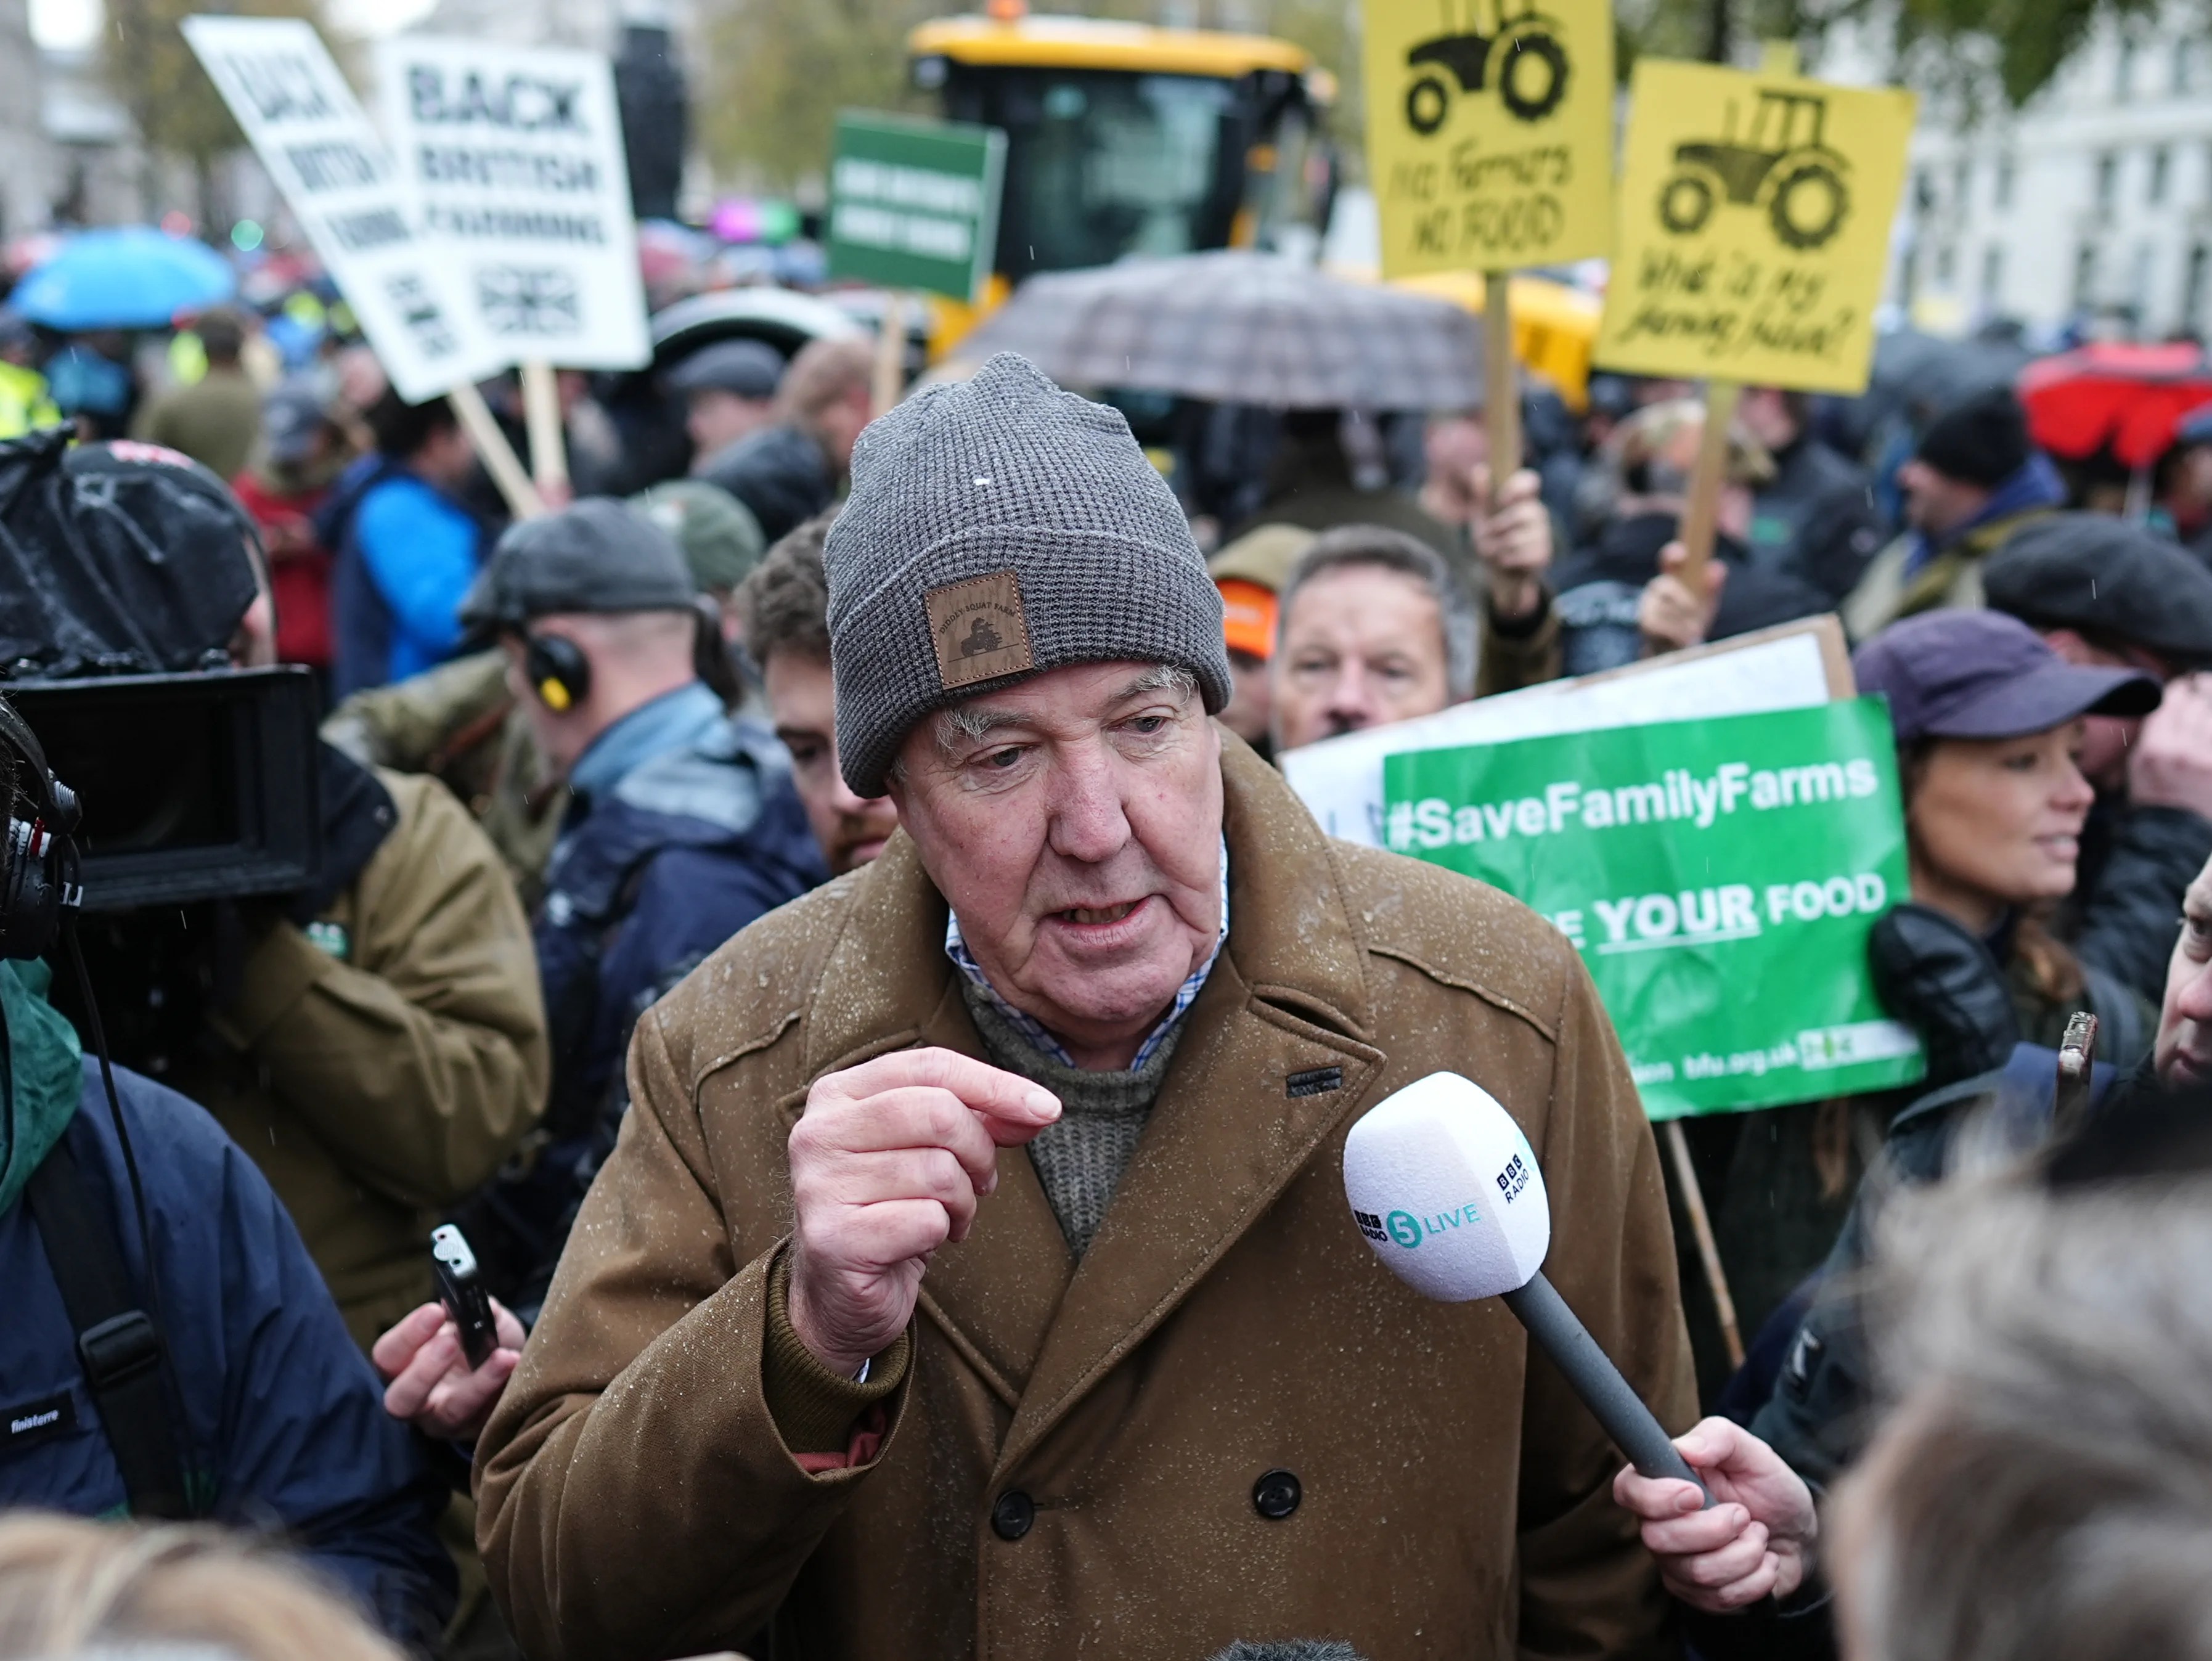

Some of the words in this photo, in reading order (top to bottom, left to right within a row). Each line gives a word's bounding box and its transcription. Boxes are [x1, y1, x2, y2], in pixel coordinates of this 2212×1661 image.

[407, 61, 589, 134] BACK
[1458, 191, 1567, 256] FOOD
[939, 609, 965, 635] DIDDLY
[965, 602, 992, 613] SQUAT
[994, 603, 1017, 618] FARM
[1386, 758, 1879, 851] #SaveFamilyFarms
[1592, 883, 1761, 943] YOUR
[1764, 871, 1888, 924] FOOD
[1496, 1153, 1523, 1191] BBC
[1504, 1168, 1529, 1204] RADIO
[1390, 1214, 1419, 1246] 5
[1424, 1203, 1481, 1235] LIVE
